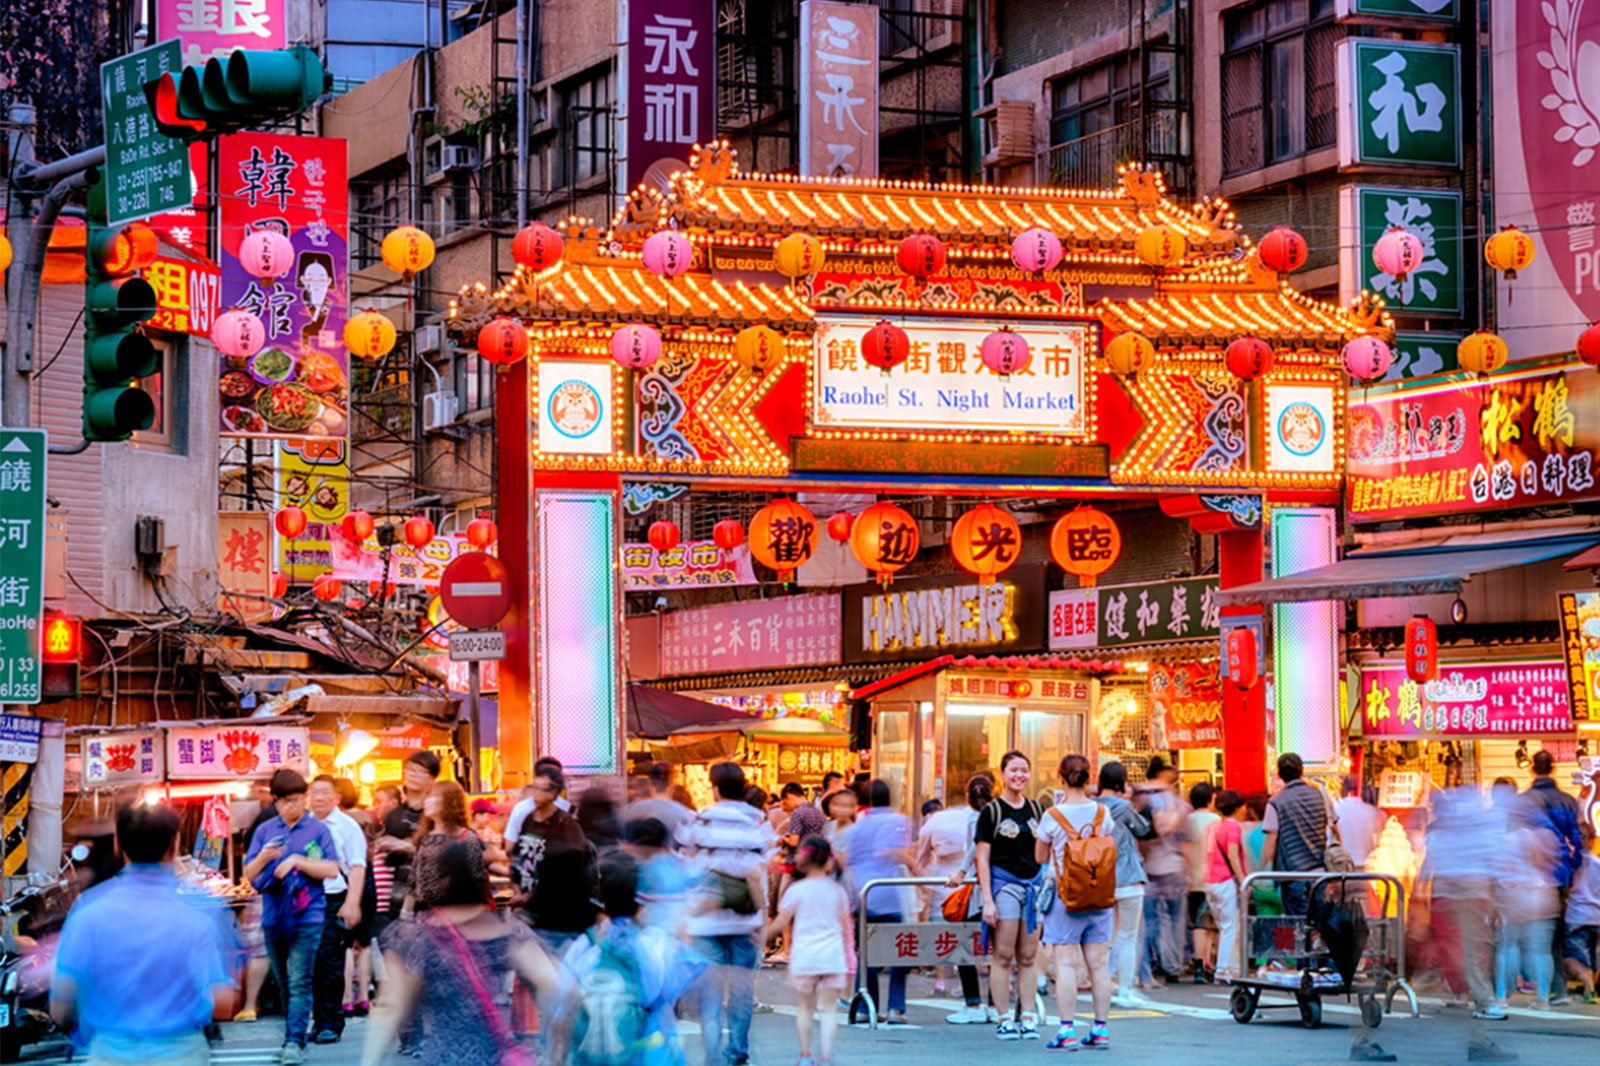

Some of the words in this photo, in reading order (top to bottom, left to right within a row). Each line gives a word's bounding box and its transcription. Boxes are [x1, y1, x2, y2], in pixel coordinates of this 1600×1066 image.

[126, 92, 147, 109] RaoH
[644, 14, 699, 144] 永和
[1368, 51, 1447, 154] 和
[113, 113, 159, 144] 八德路
[234, 146, 297, 339] 韓館
[1567, 201, 1597, 252] 警
[144, 261, 189, 311] 租
[826, 337, 1072, 379] 饒街觀市
[823, 385, 886, 406] Raohe
[898, 387, 923, 408] St.
[936, 387, 990, 413] Night
[1003, 386, 1075, 411] Market
[1481, 376, 1576, 456] 松鶴
[0, 459, 32, 608] 饒河街
[768, 516, 814, 562] 歡
[877, 521, 916, 564] 迎
[971, 522, 1016, 562] 光
[1067, 525, 1111, 562] 臨
[0, 614, 36, 631] aoHe
[711, 613, 783, 657] 三禾百貨
[862, 582, 1008, 651] HAMMER
[18, 657, 34, 673] 33
[452, 637, 502, 653] 16:00-24:00
[14, 681, 38, 698] 255
[1366, 677, 1422, 731] 松鶴
